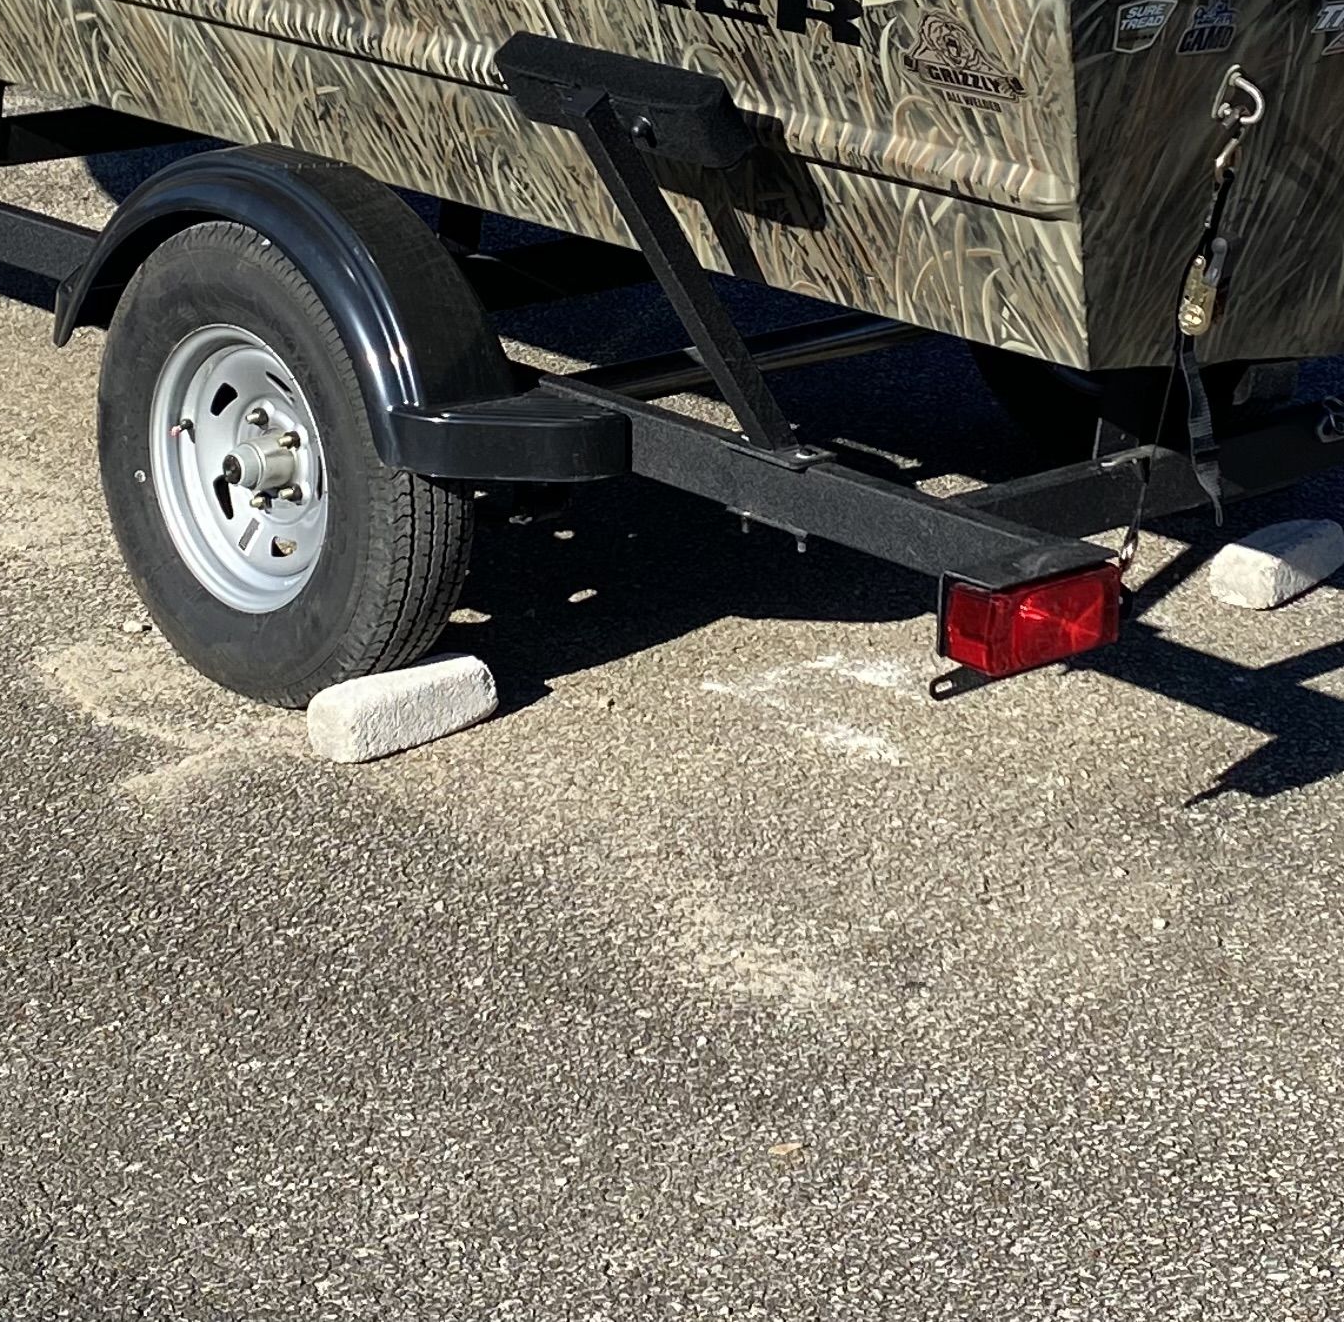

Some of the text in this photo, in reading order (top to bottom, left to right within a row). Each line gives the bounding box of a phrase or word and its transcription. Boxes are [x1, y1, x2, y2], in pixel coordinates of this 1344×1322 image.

[1126, 3, 1167, 19] SURE
[1120, 15, 1166, 31] TREAD
[927, 63, 1001, 94] GRIZZLY
